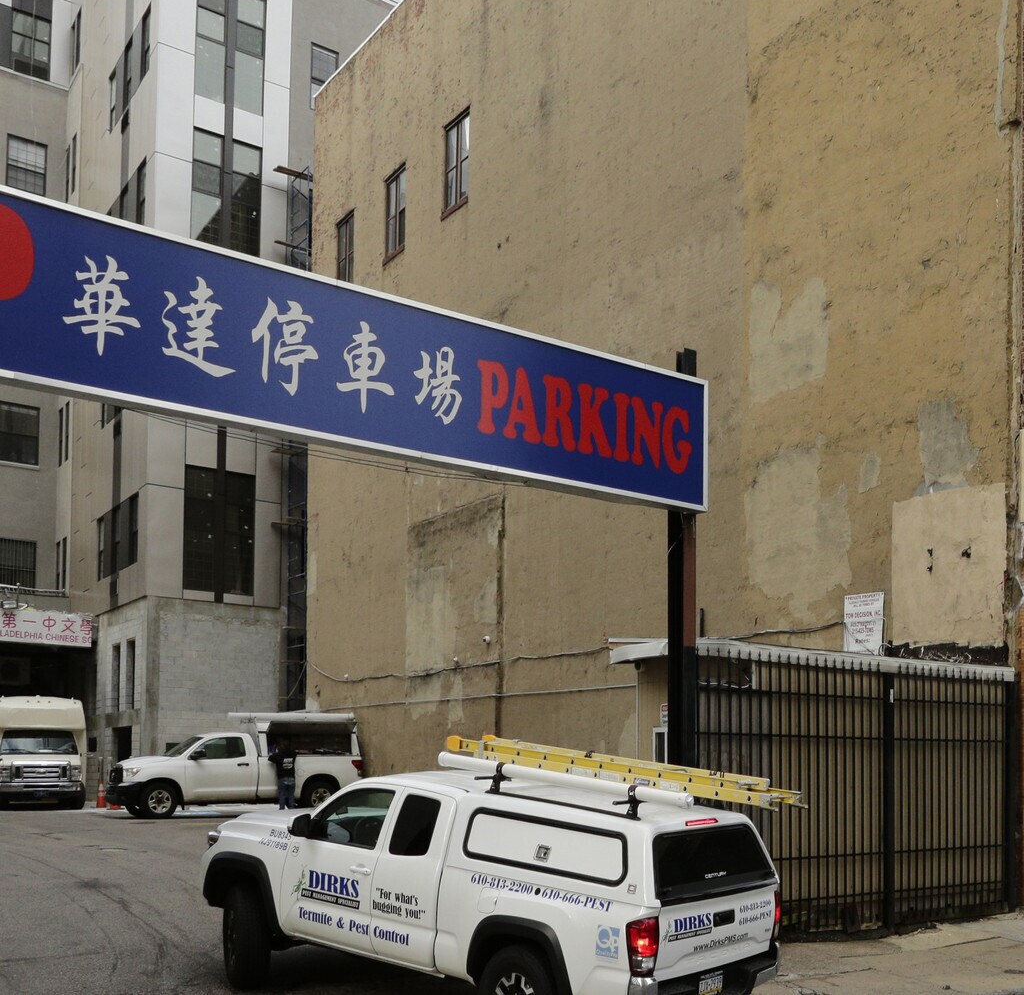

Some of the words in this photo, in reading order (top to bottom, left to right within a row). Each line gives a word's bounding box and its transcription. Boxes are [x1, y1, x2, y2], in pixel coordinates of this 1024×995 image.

[62, 255, 465, 425] 華達停車場
[476, 358, 693, 475] PARKING
[45, 633, 79, 643] CHINESE
[308, 869, 359, 899] DIRKS
[704, 871, 727, 879] CENTURY
[394, 891, 419, 907] what's
[470, 873, 534, 895] 610-813-2200
[541, 887, 613, 912] 610-666-PEST
[372, 899, 402, 917] bugging
[298, 906, 333, 927] Termite
[336, 917, 345, 929] &
[349, 919, 370, 936] Pest
[373, 926, 410, 946] Control
[673, 912, 712, 934] DIRKS
[693, 931, 749, 953] www.DirksPMS.com
